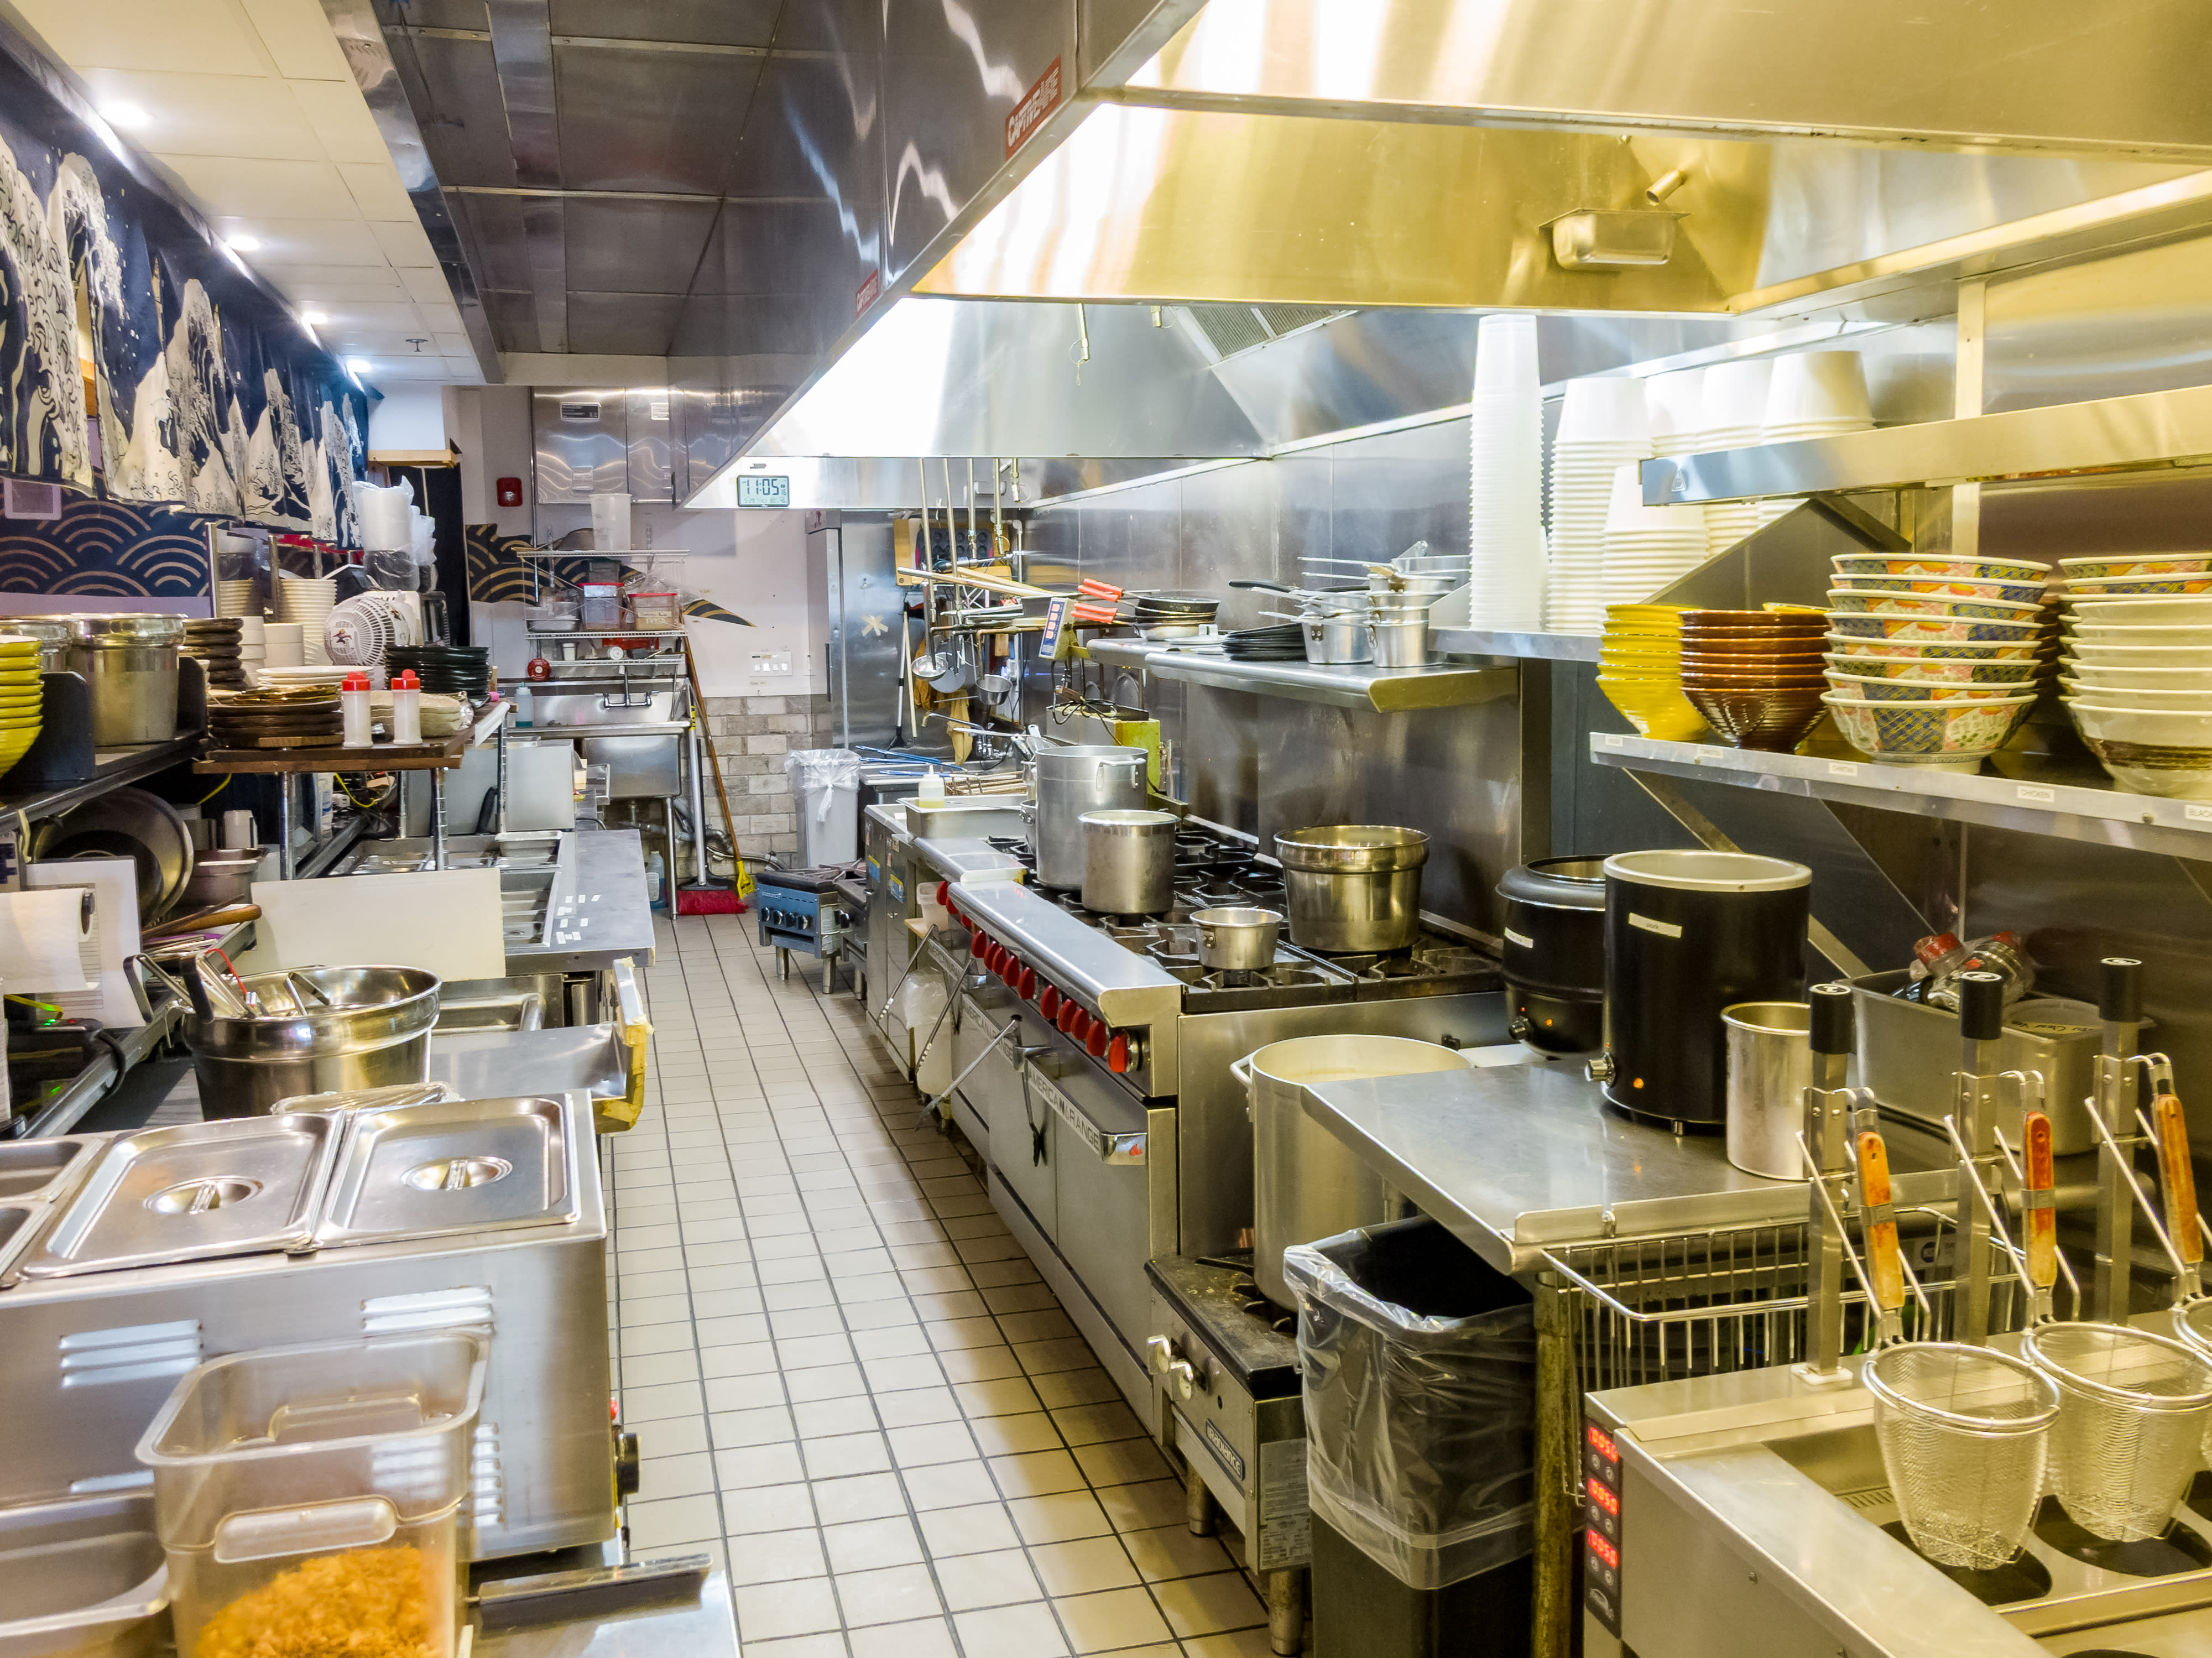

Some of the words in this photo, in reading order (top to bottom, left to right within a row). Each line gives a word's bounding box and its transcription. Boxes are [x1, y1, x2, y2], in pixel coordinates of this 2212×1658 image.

[747, 478, 779, 495] 11:05
[1029, 1068, 1065, 1115] AMERICAN
[1070, 1107, 1100, 1151] RANGE
